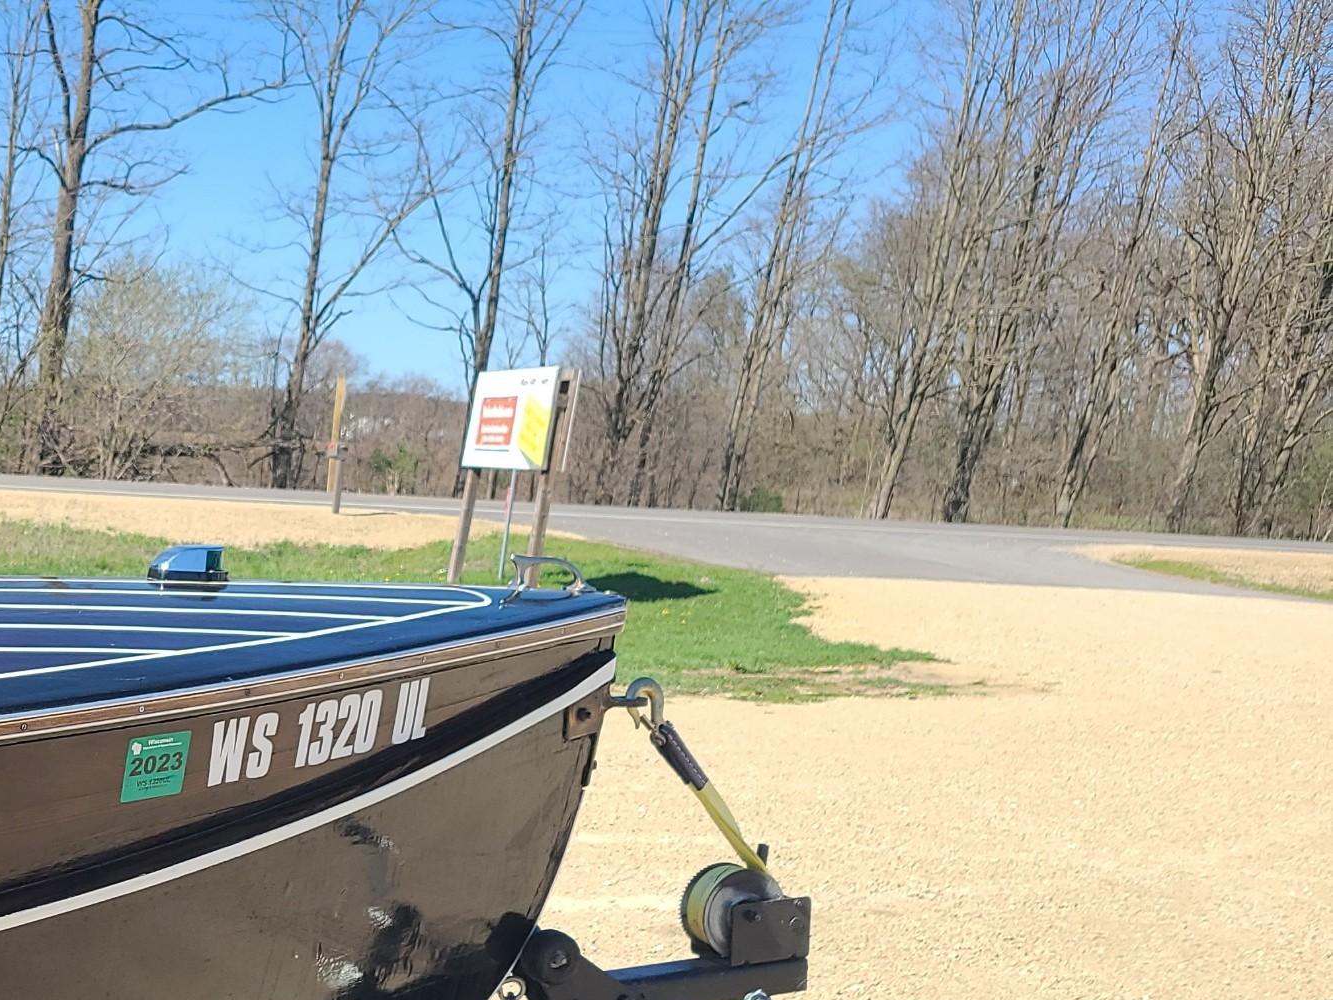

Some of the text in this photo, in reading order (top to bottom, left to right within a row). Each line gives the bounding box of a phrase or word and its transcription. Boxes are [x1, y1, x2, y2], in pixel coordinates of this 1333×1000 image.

[129, 751, 183, 777] 2023
[207, 678, 430, 787] WS 1320 UL
